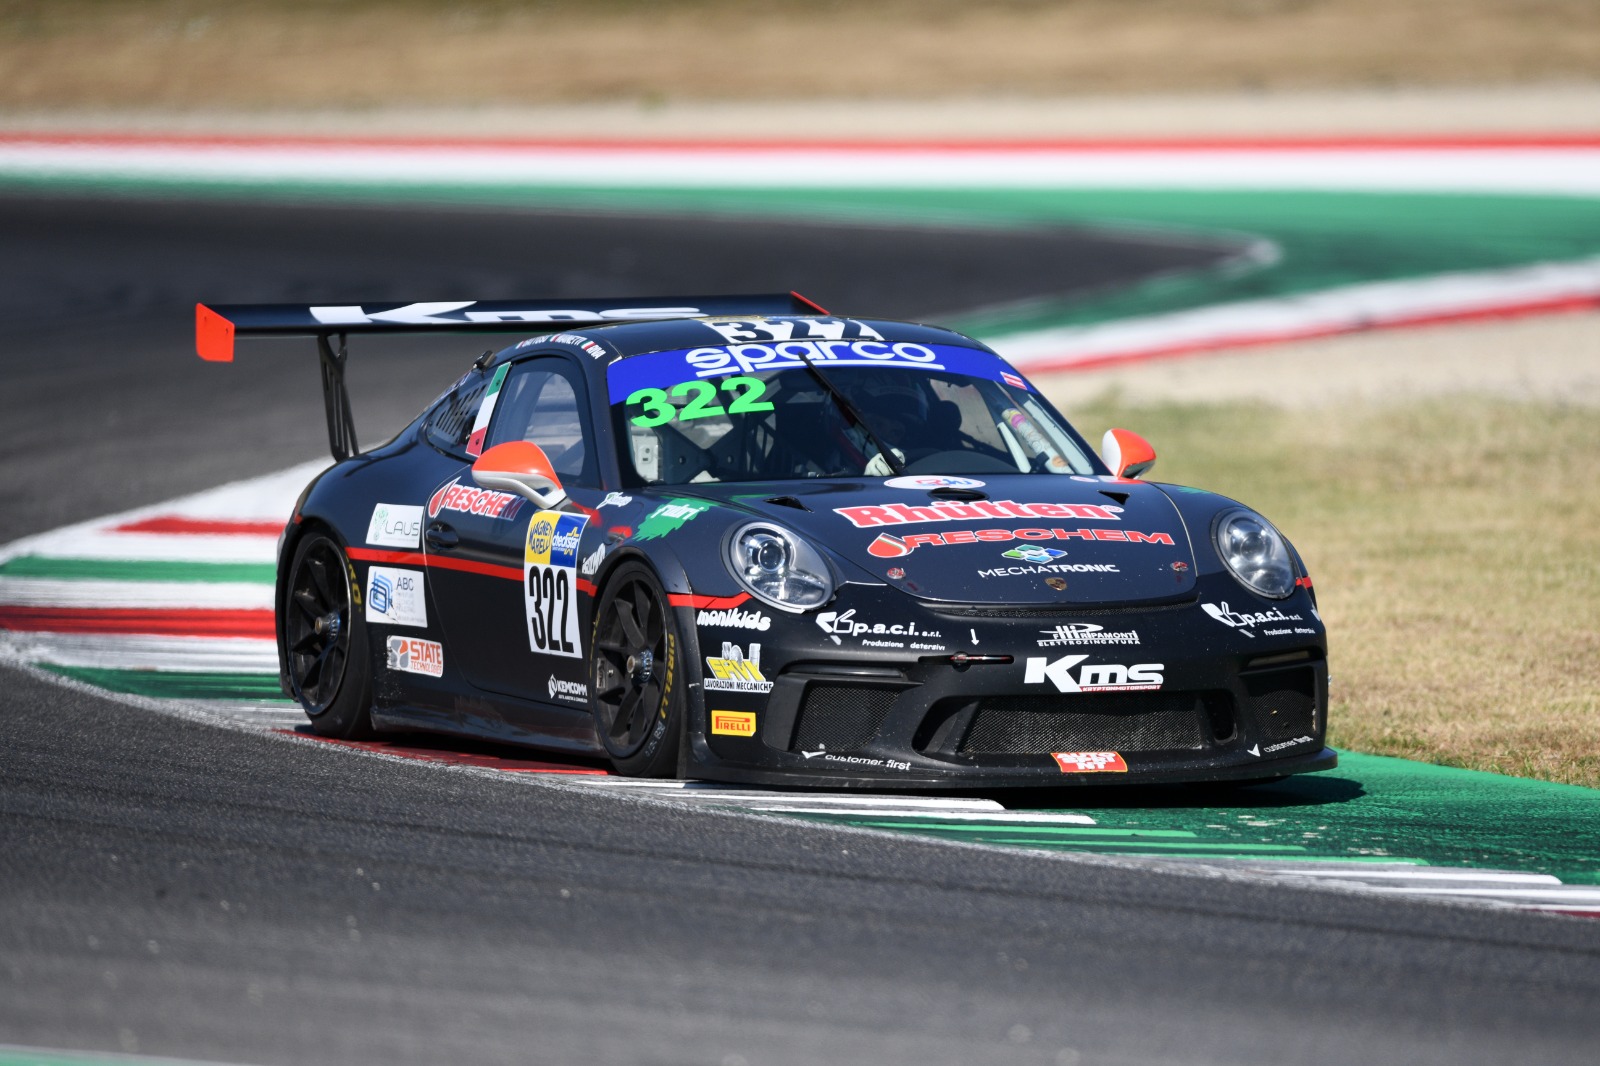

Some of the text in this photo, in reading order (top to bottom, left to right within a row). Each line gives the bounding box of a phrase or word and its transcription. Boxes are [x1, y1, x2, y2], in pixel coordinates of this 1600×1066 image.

[685, 341, 936, 373] sparco
[625, 376, 775, 429] 322
[440, 484, 528, 521] RESCHEM
[385, 520, 419, 537] LAUS
[901, 529, 1175, 548] RESCHEM
[977, 564, 1120, 578] MECHATRONIC
[396, 577, 414, 591] ABC
[528, 565, 574, 654] 322
[697, 608, 771, 631] monikids
[410, 641, 442, 664] STATE
[862, 639, 905, 649] Produzione
[410, 660, 442, 675] TECHNOLOGIES
[660, 632, 675, 719] PIRELLI
[1024, 654, 1165, 693] Kms
[557, 680, 588, 697] KEMCOMM
[704, 679, 735, 690] LAVORAZIONI
[715, 715, 751, 732] PIRELLI
[825, 754, 911, 771] customer first
